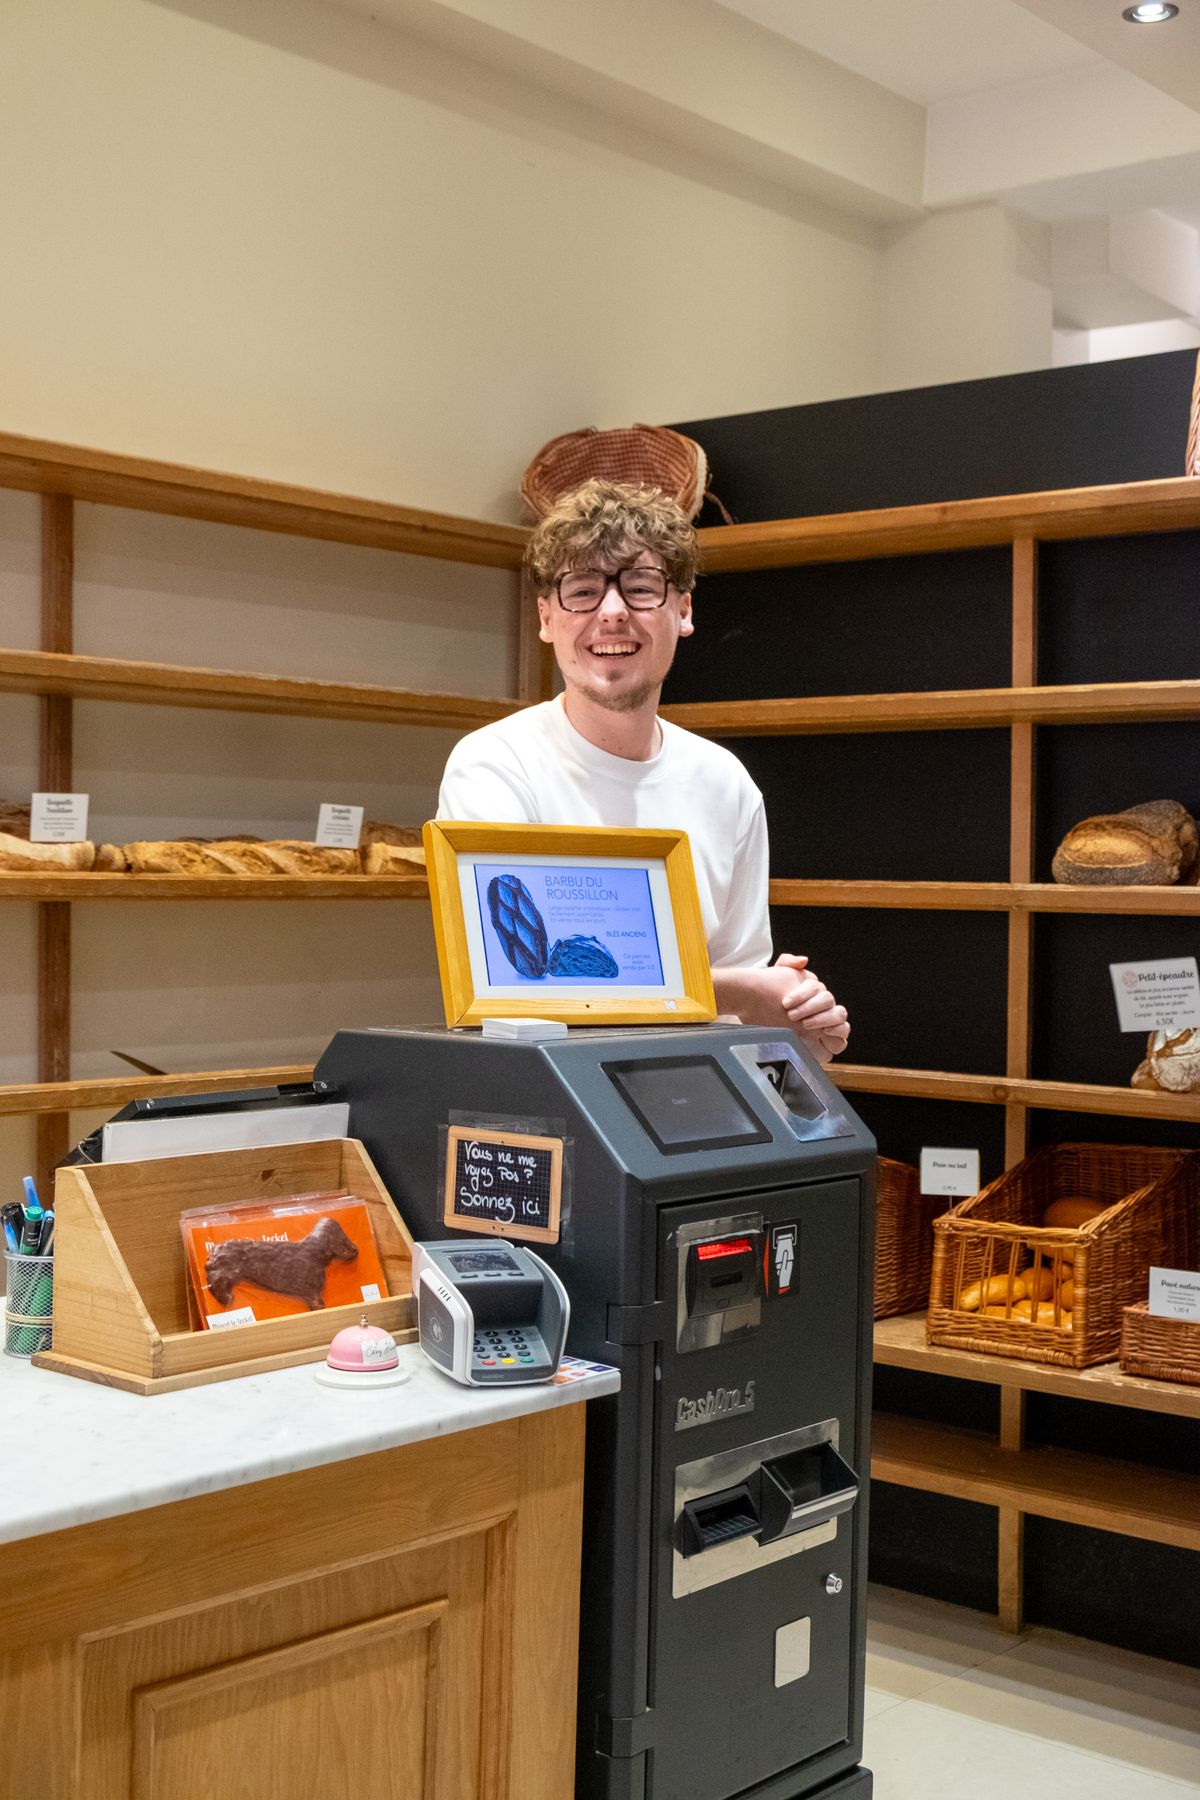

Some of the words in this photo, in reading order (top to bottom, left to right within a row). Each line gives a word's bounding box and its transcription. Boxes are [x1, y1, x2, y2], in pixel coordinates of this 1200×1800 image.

[545, 875, 583, 888] BARBU
[586, 876, 603, 888] DU
[546, 888, 618, 901] ROUSSILLON
[621, 930, 647, 938] ANCIENS
[464, 1141, 493, 1160] Vous
[498, 1152, 514, 1163] ne
[518, 1155, 537, 1168] me
[523, 1169, 534, 1185] ?
[460, 1186, 516, 1225] Sonnez
[522, 1196, 540, 1215] ici
